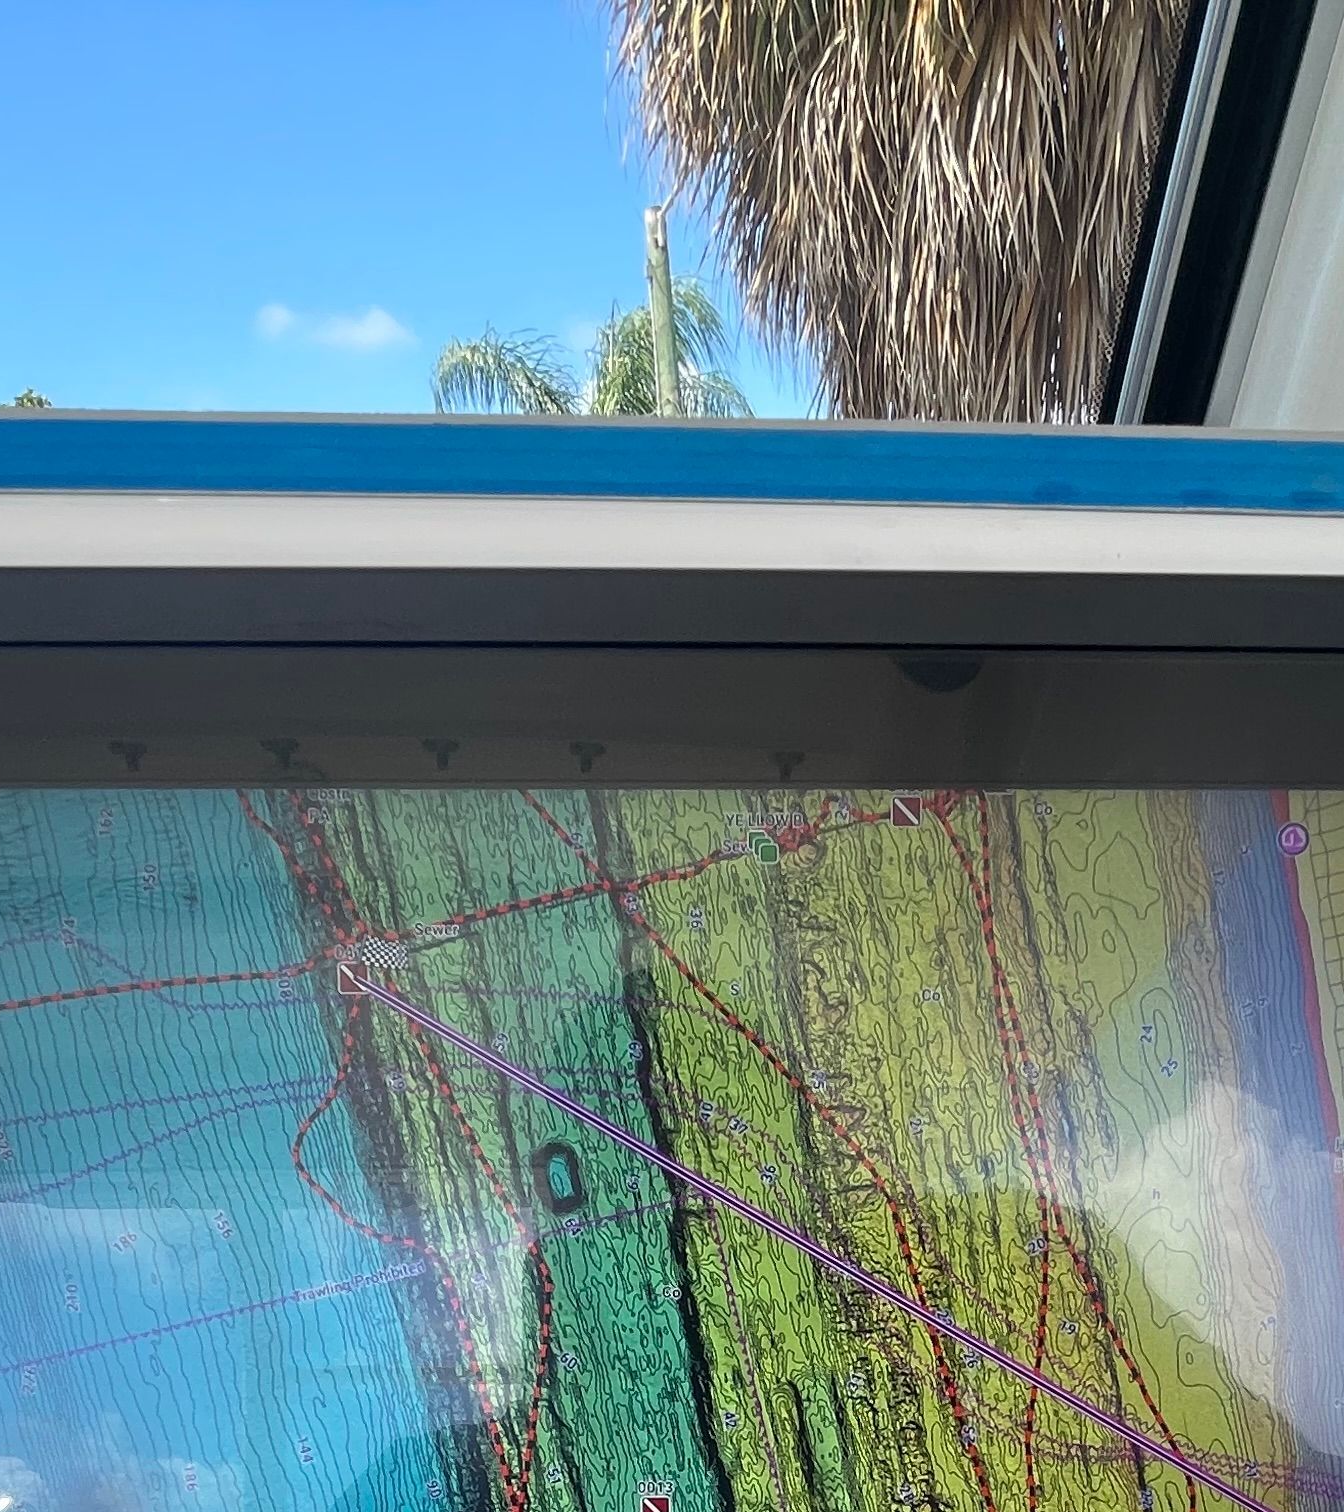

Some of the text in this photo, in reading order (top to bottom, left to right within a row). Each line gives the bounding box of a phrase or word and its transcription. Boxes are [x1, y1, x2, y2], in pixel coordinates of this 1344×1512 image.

[414, 923, 459, 937] Sewer
[212, 1210, 234, 1241] 156
[112, 1231, 138, 1253] 186
[293, 1279, 353, 1302] Trawling
[558, 1352, 579, 1371] 60
[637, 1481, 674, 1494] 0013
